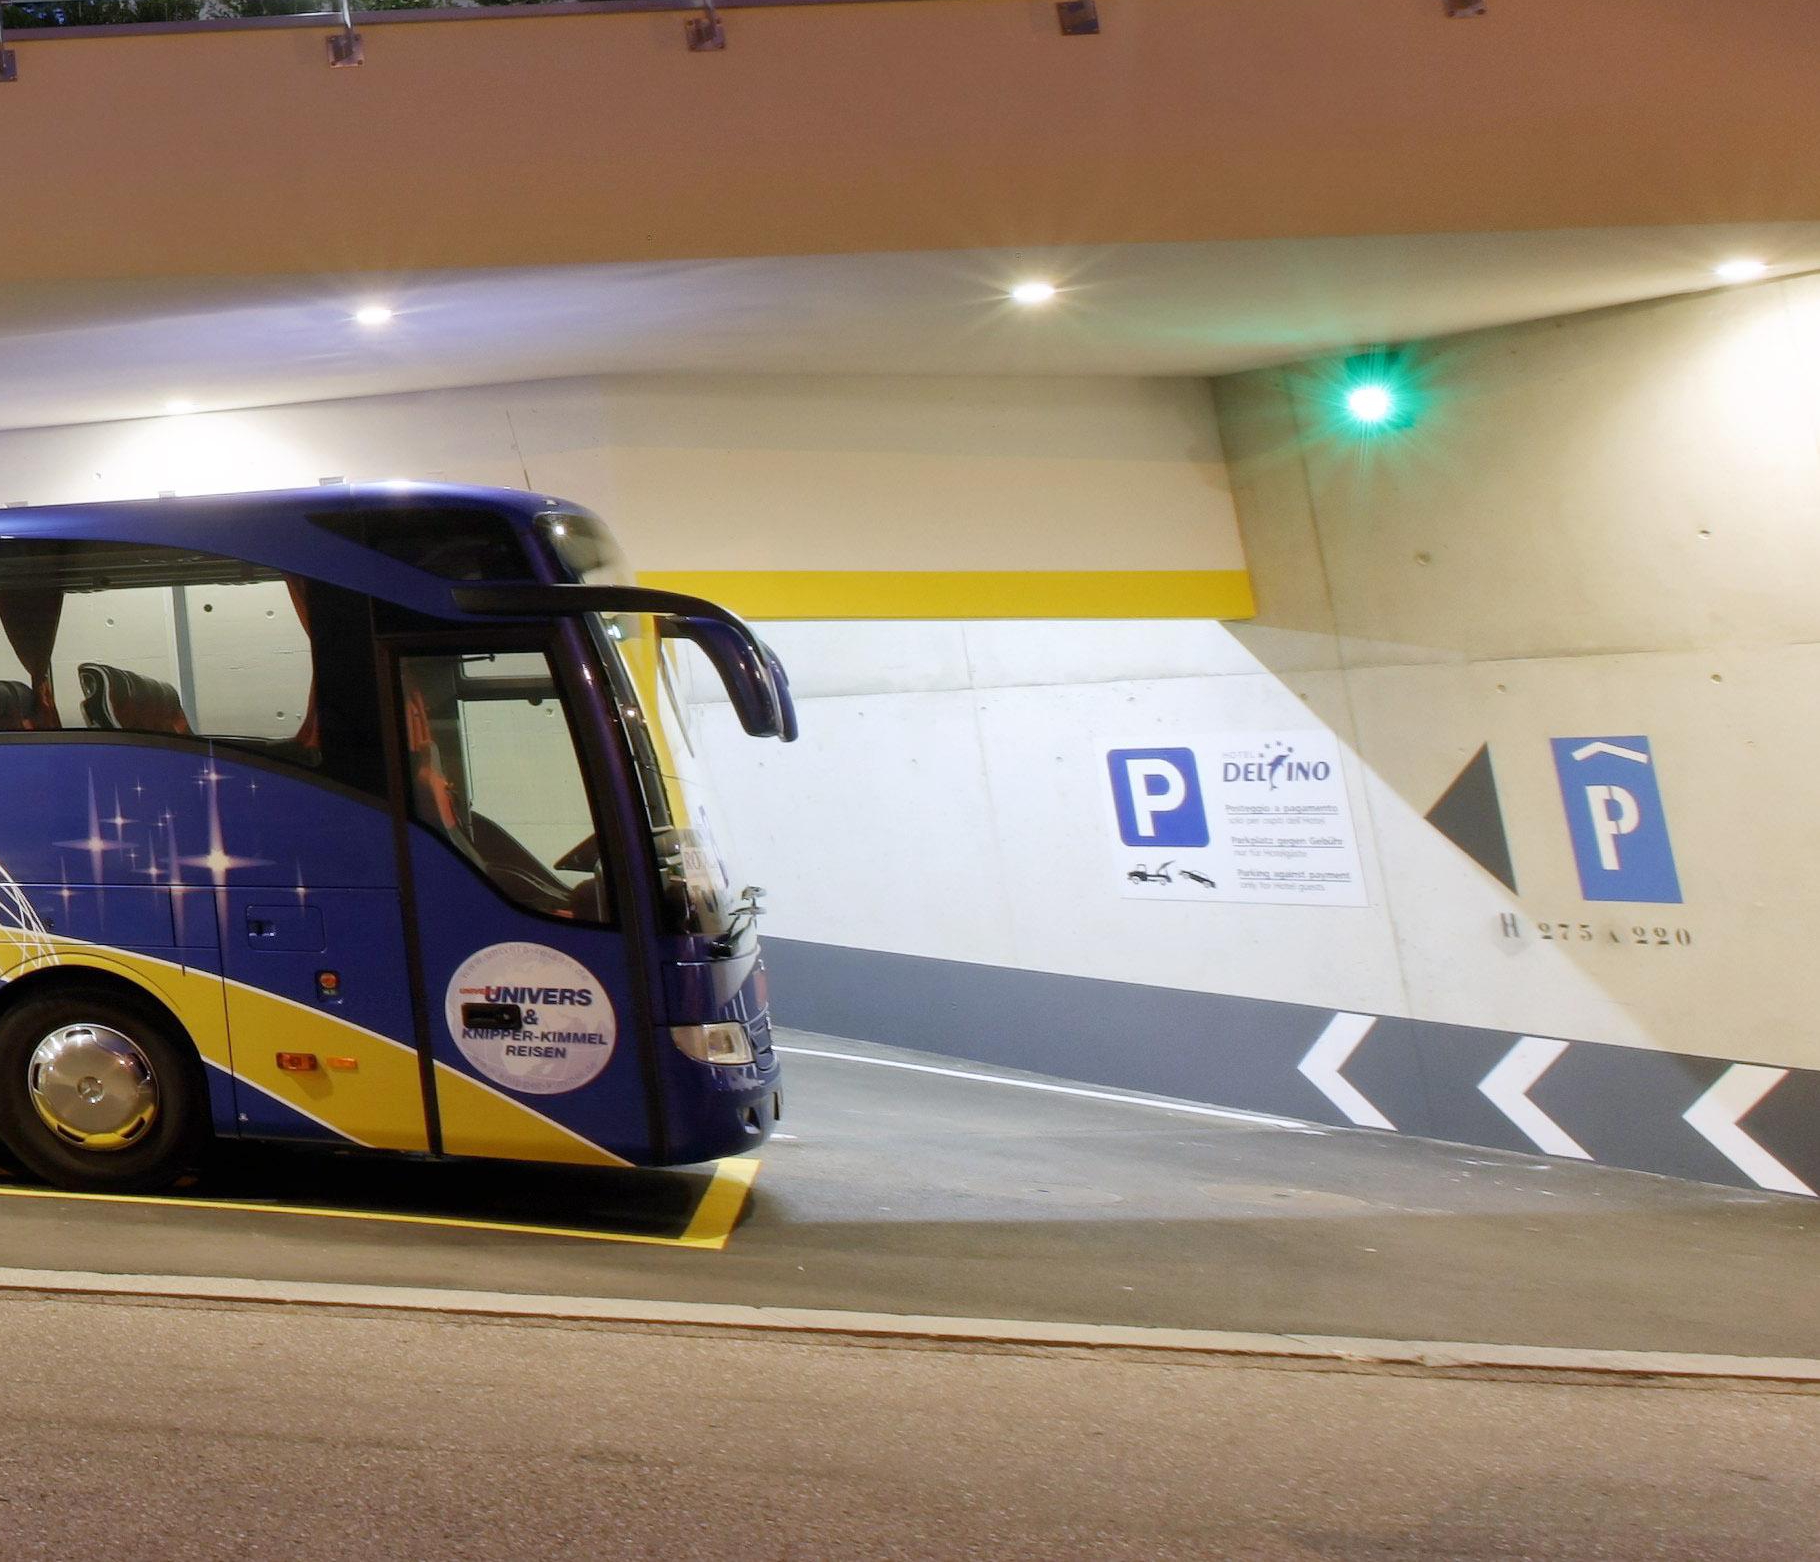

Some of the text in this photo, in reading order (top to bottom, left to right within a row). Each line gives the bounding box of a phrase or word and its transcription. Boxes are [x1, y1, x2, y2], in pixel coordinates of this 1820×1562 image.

[1125, 758, 1186, 837] P
[1284, 805, 1338, 814] pagamento
[1585, 785, 1640, 871] P
[1231, 836, 1273, 846] Parkplatz
[1238, 869, 1270, 878] Parking
[1309, 872, 1350, 880] payment
[1500, 912, 1520, 938] H
[1537, 922, 1593, 942] 275
[1632, 926, 1692, 946] 220
[484, 985, 592, 1006] UNIVERS
[522, 1008, 539, 1026] &
[462, 1027, 609, 1046] KNIPPER-KIMMEL
[505, 1044, 567, 1059] REISEN
